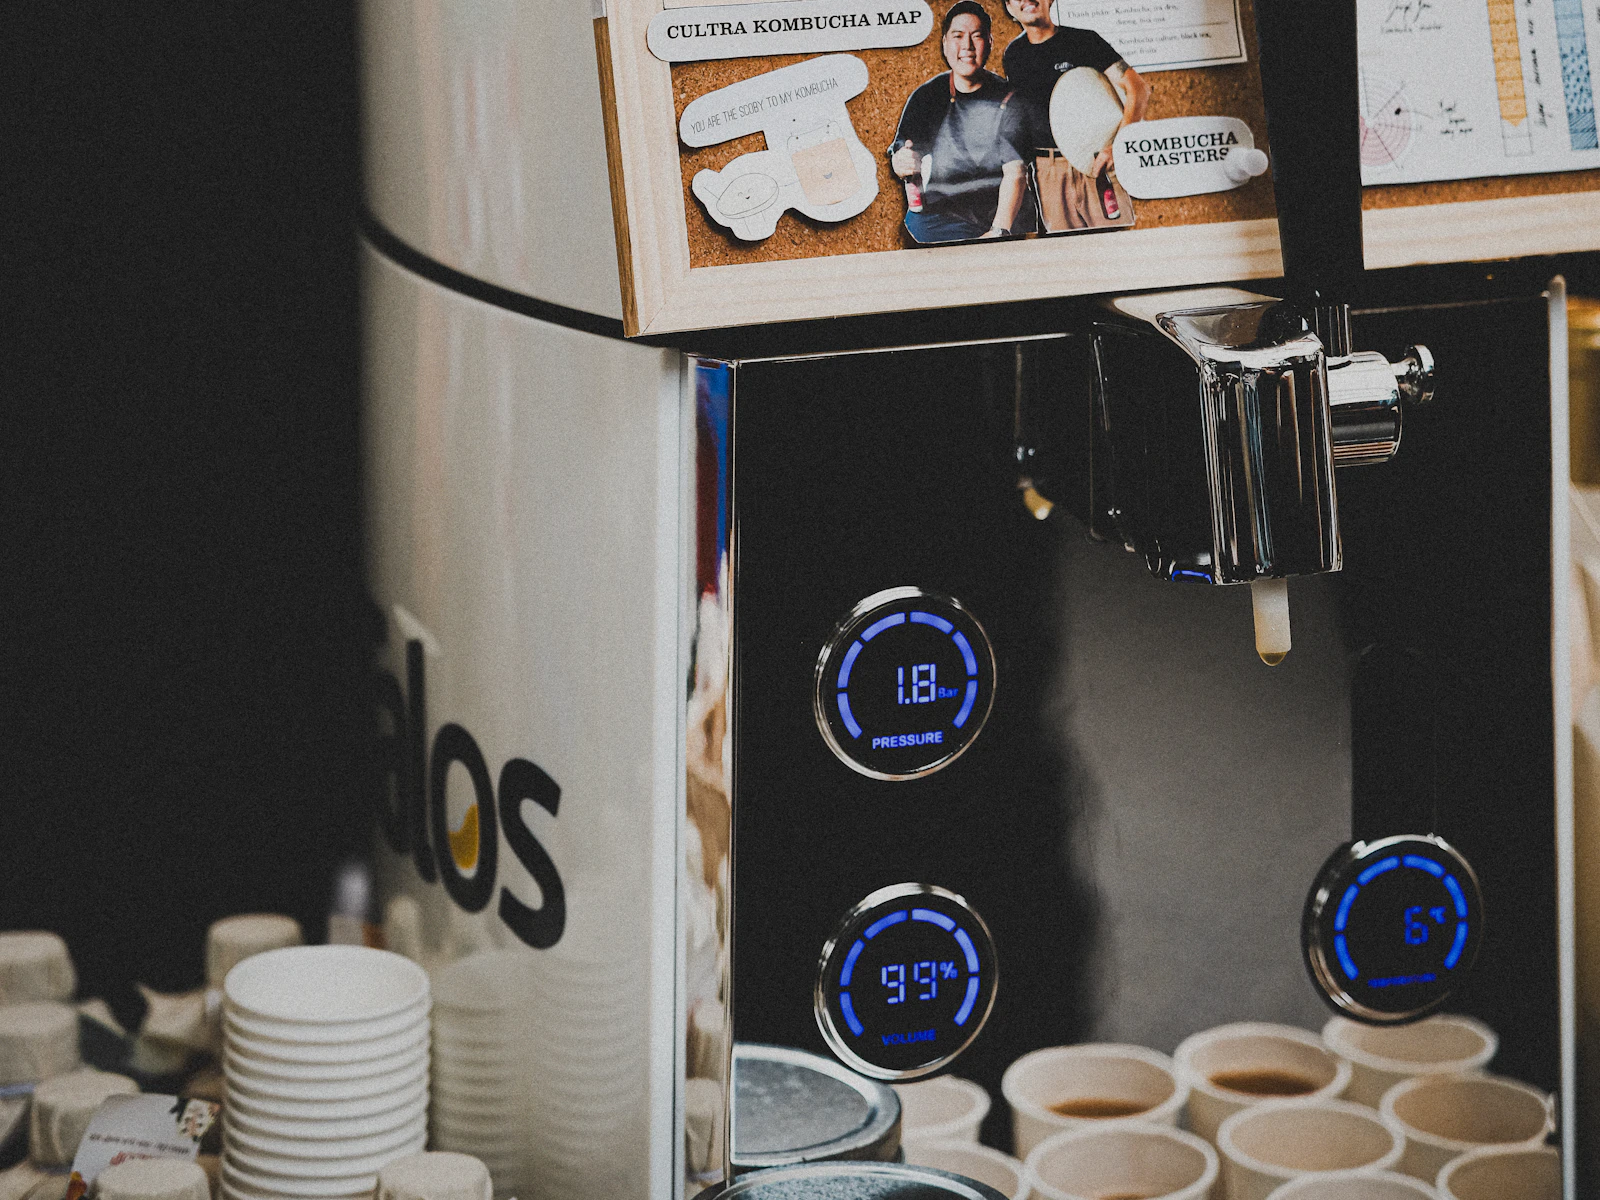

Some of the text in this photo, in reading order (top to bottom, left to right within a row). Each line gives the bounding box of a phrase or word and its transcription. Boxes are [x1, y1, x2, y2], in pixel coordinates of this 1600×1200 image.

[667, 10, 923, 40] CULTRA KOMBUCHA MAP
[690, 77, 839, 135] YOU ARE THE SCOBY TO MY KOMBUCHA
[1124, 131, 1239, 154] KOMBUCHA
[1138, 147, 1229, 168] MASTERS
[897, 663, 959, 705] 1.8 Bar
[872, 731, 944, 750] PRESSURE
[881, 1029, 937, 1046] VOLUME
